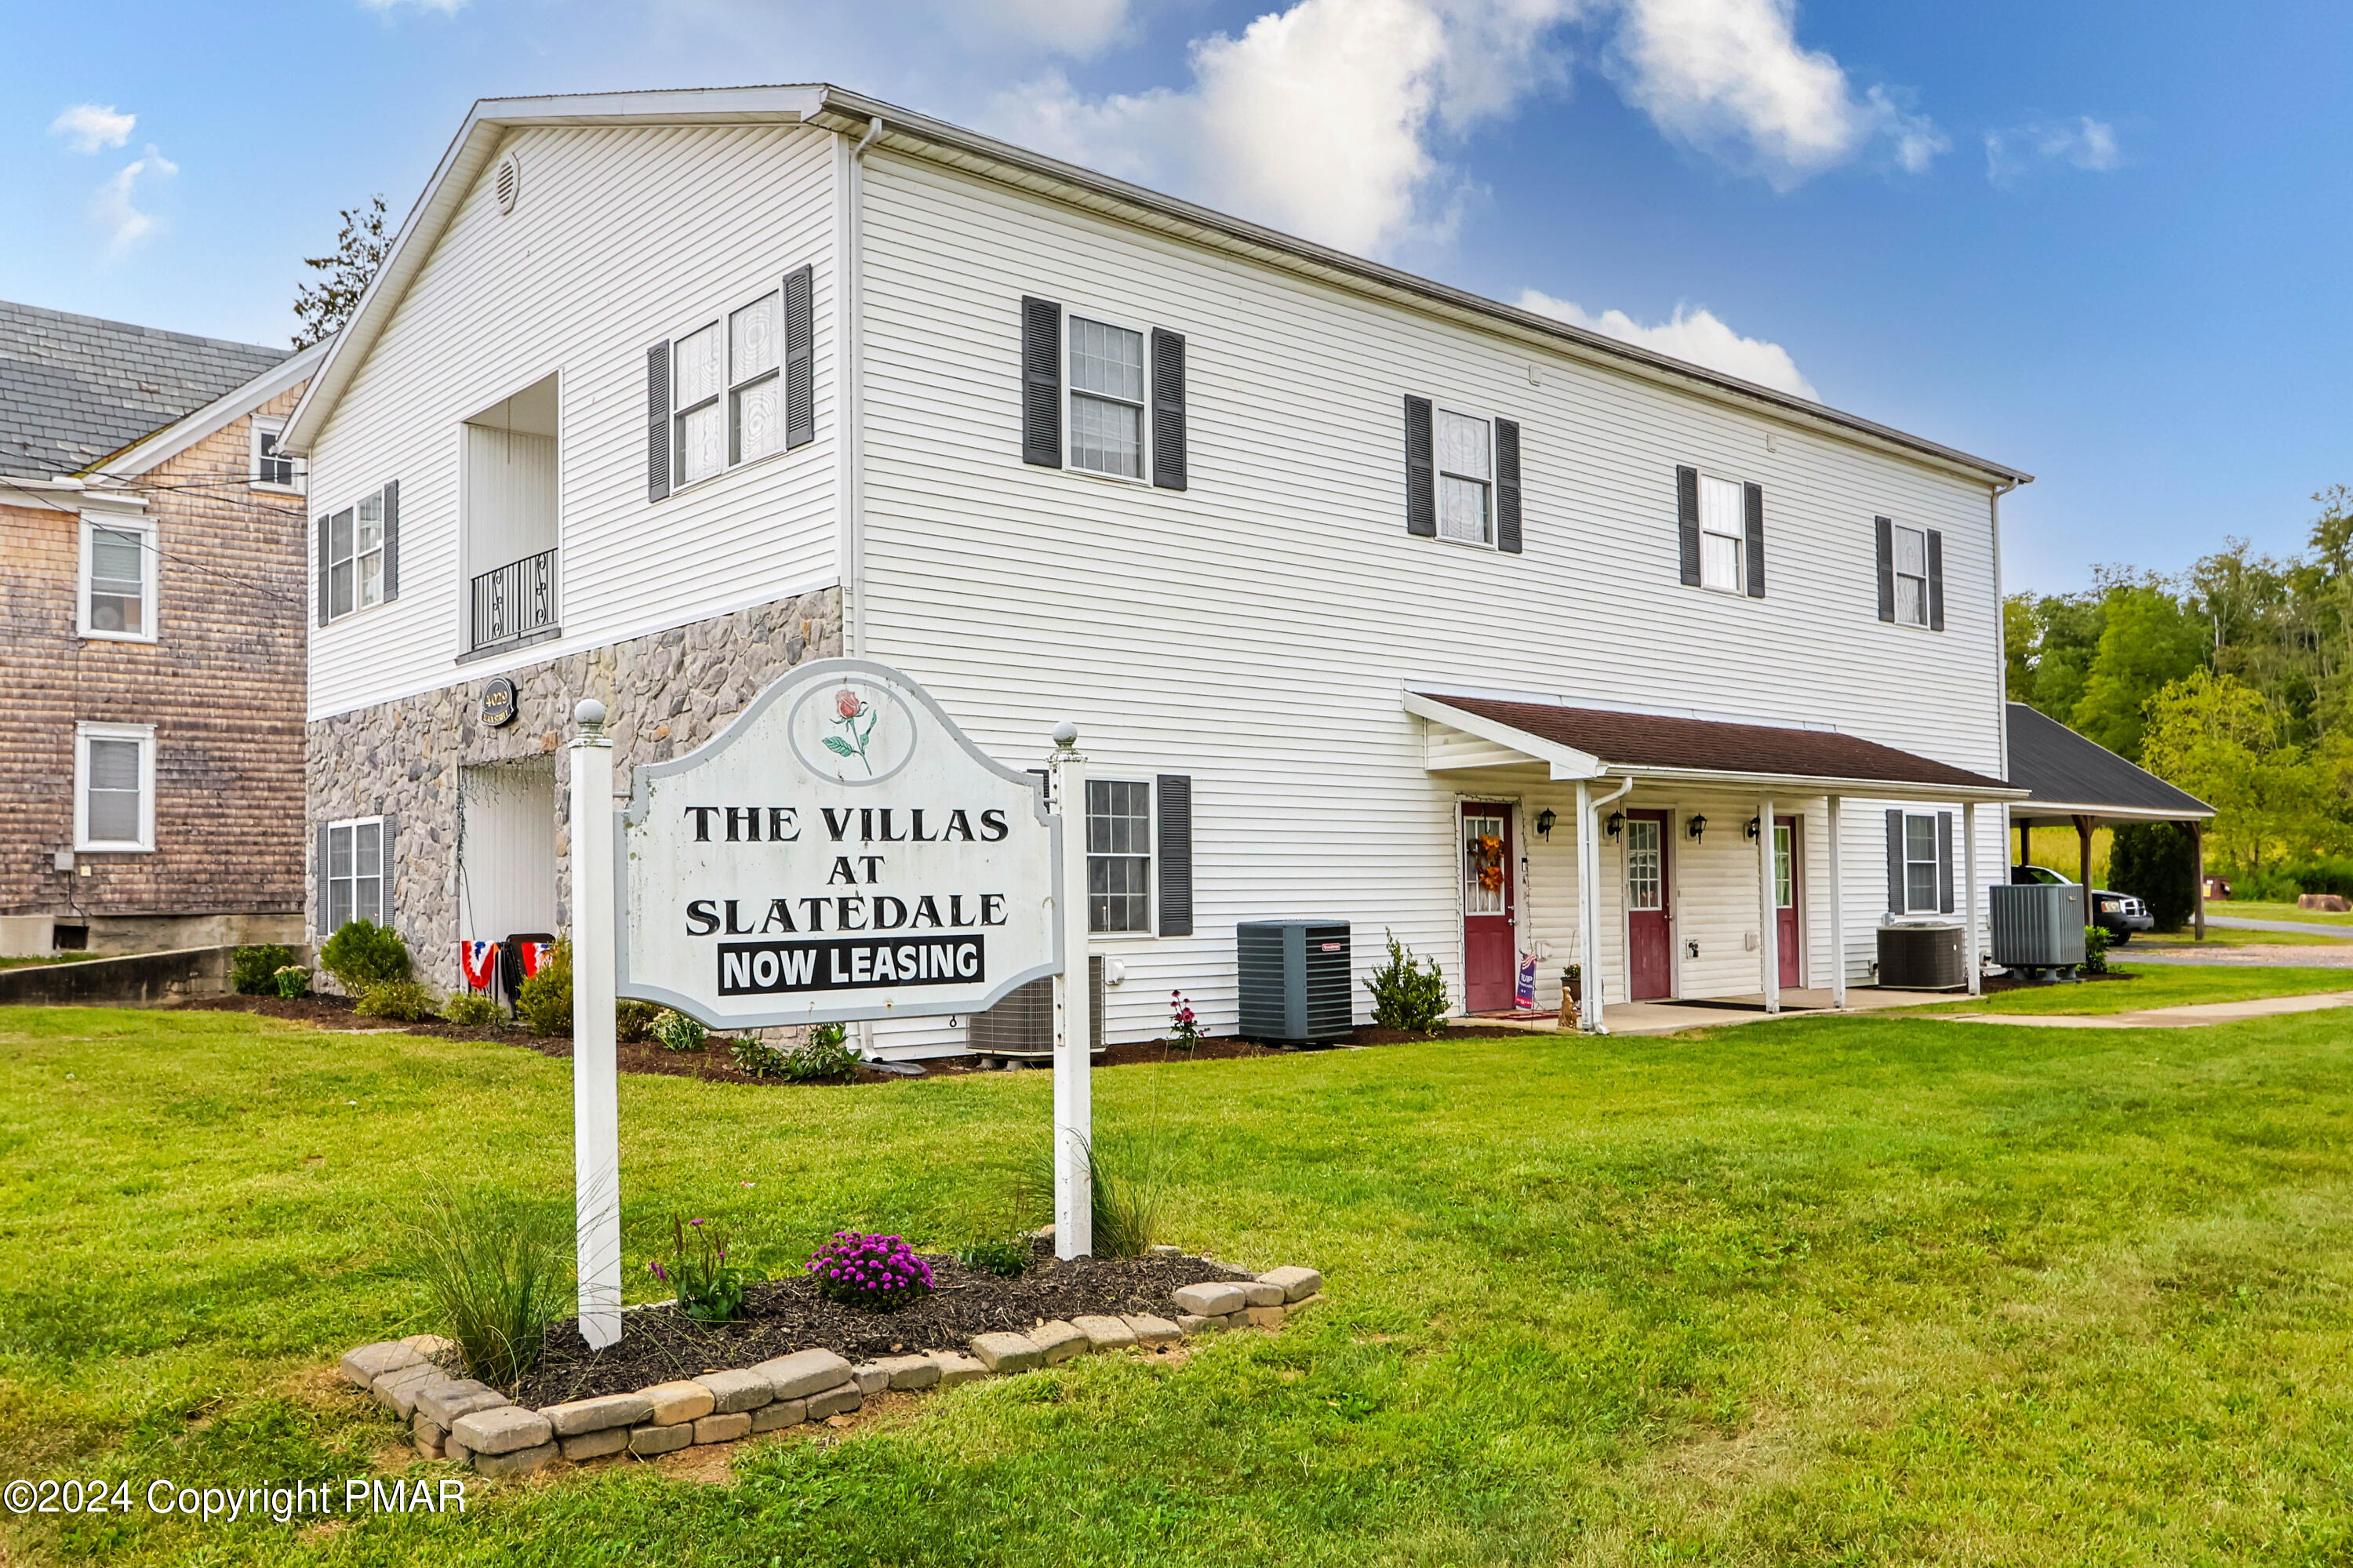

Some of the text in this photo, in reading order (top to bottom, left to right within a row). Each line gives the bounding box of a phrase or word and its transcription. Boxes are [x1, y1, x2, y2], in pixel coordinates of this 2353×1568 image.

[486, 690, 507, 707] 4029
[683, 806, 1009, 842] THE VILLAS
[827, 856, 886, 885] AT
[686, 893, 1009, 937] SLATEDALE
[723, 943, 978, 989] NOW LEASING
